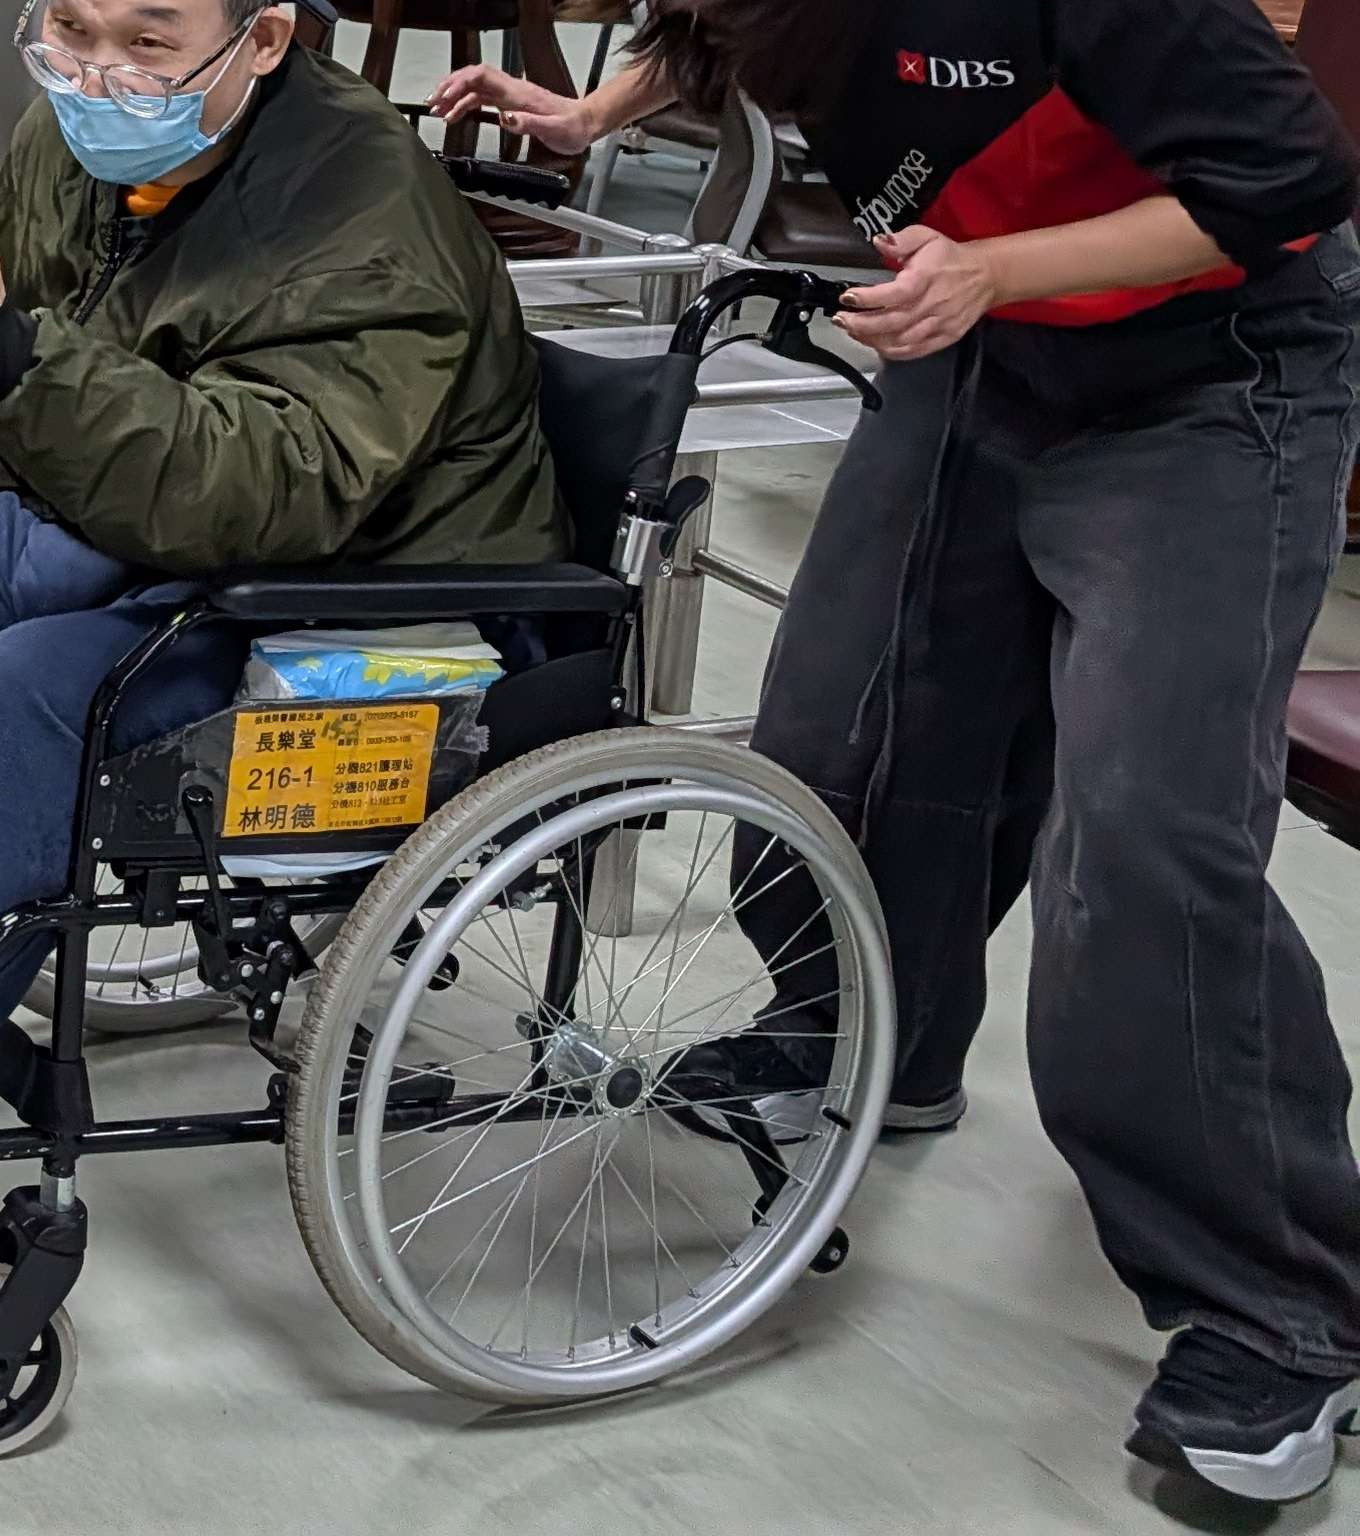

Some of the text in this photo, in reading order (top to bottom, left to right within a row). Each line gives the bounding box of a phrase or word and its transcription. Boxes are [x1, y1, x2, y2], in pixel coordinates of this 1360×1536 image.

[929, 56, 1016, 89] DBS
[871, 149, 933, 235] purpose
[256, 728, 317, 753] 長樂堂
[247, 766, 313, 791] 216-1
[335, 758, 414, 776] 分機821護理站
[332, 777, 410, 794] 分機810服務台
[238, 803, 317, 833] 林明德
